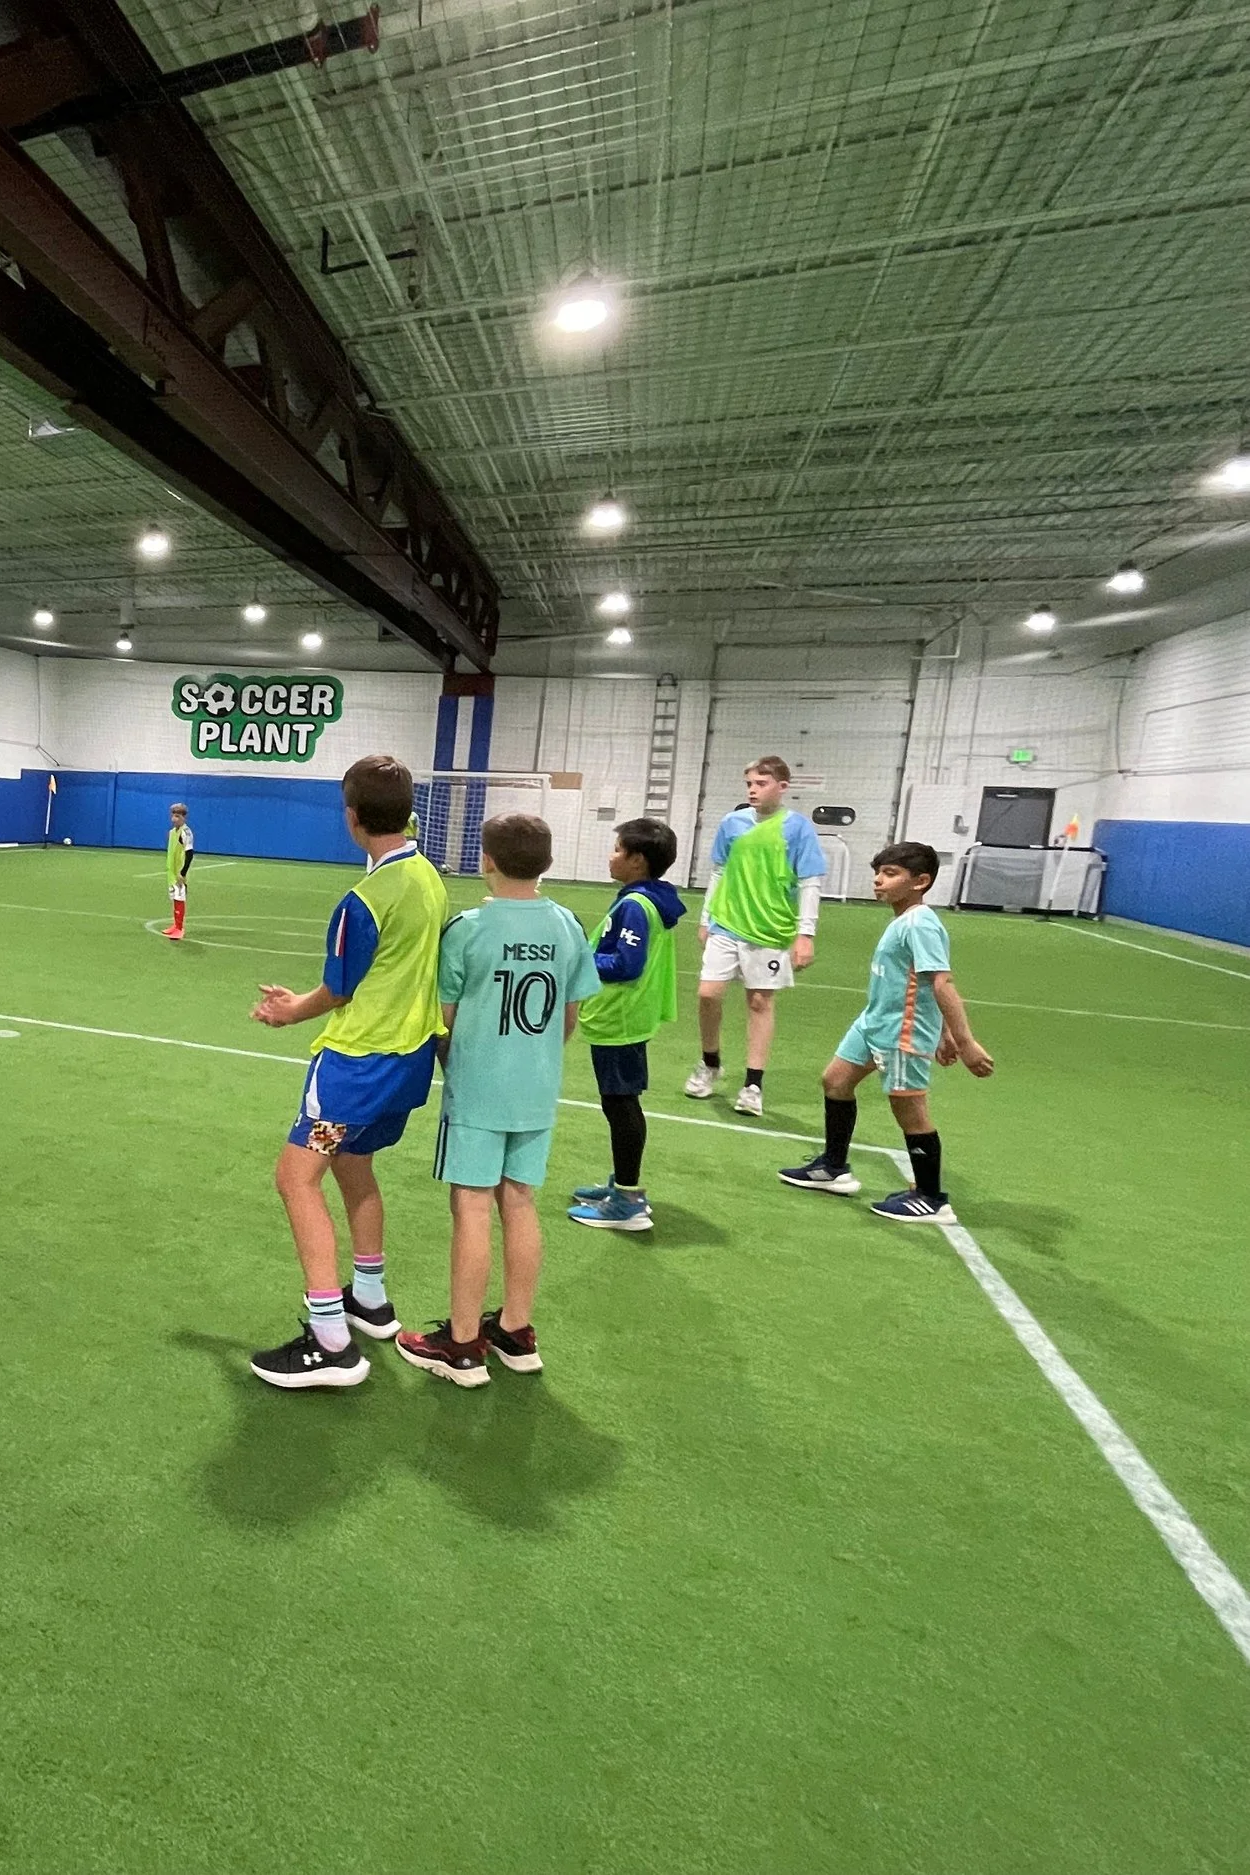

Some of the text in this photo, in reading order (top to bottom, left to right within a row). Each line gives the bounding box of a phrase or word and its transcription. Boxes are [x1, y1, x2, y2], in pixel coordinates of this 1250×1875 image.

[179, 682, 335, 716] SOCCER
[198, 721, 316, 755] PLANT
[503, 943, 556, 962] MESSI
[767, 960, 781, 977] 9
[493, 970, 557, 1036] 10
